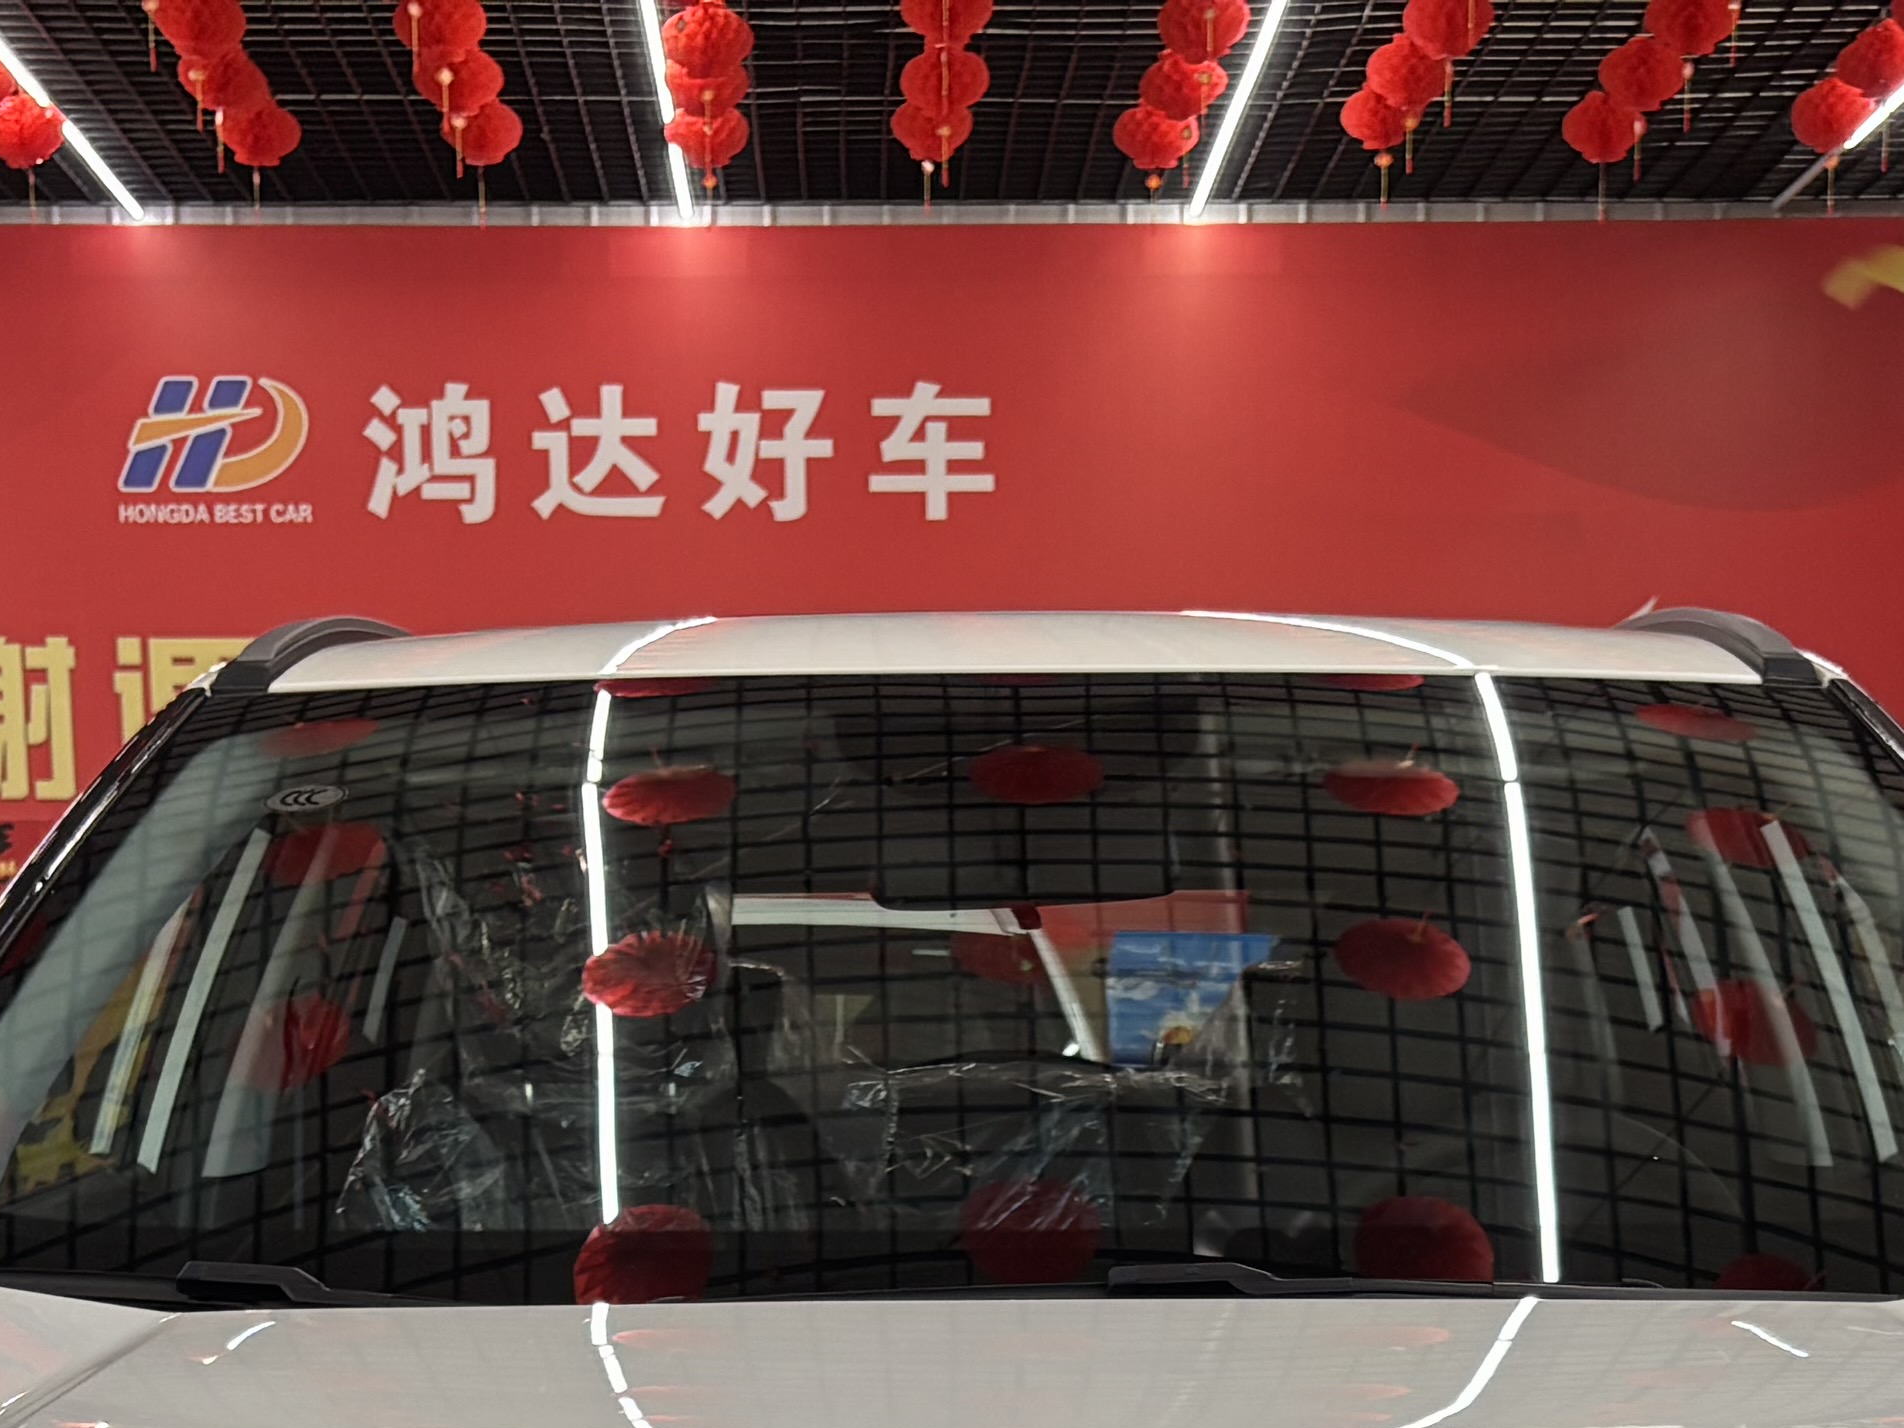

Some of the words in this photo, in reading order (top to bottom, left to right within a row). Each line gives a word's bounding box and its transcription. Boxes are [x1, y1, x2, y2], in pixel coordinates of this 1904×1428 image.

[362, 381, 996, 524] 鸿达好车
[118, 504, 210, 523] HONGDA
[214, 504, 265, 523] BEST
[269, 504, 313, 523] CAR
